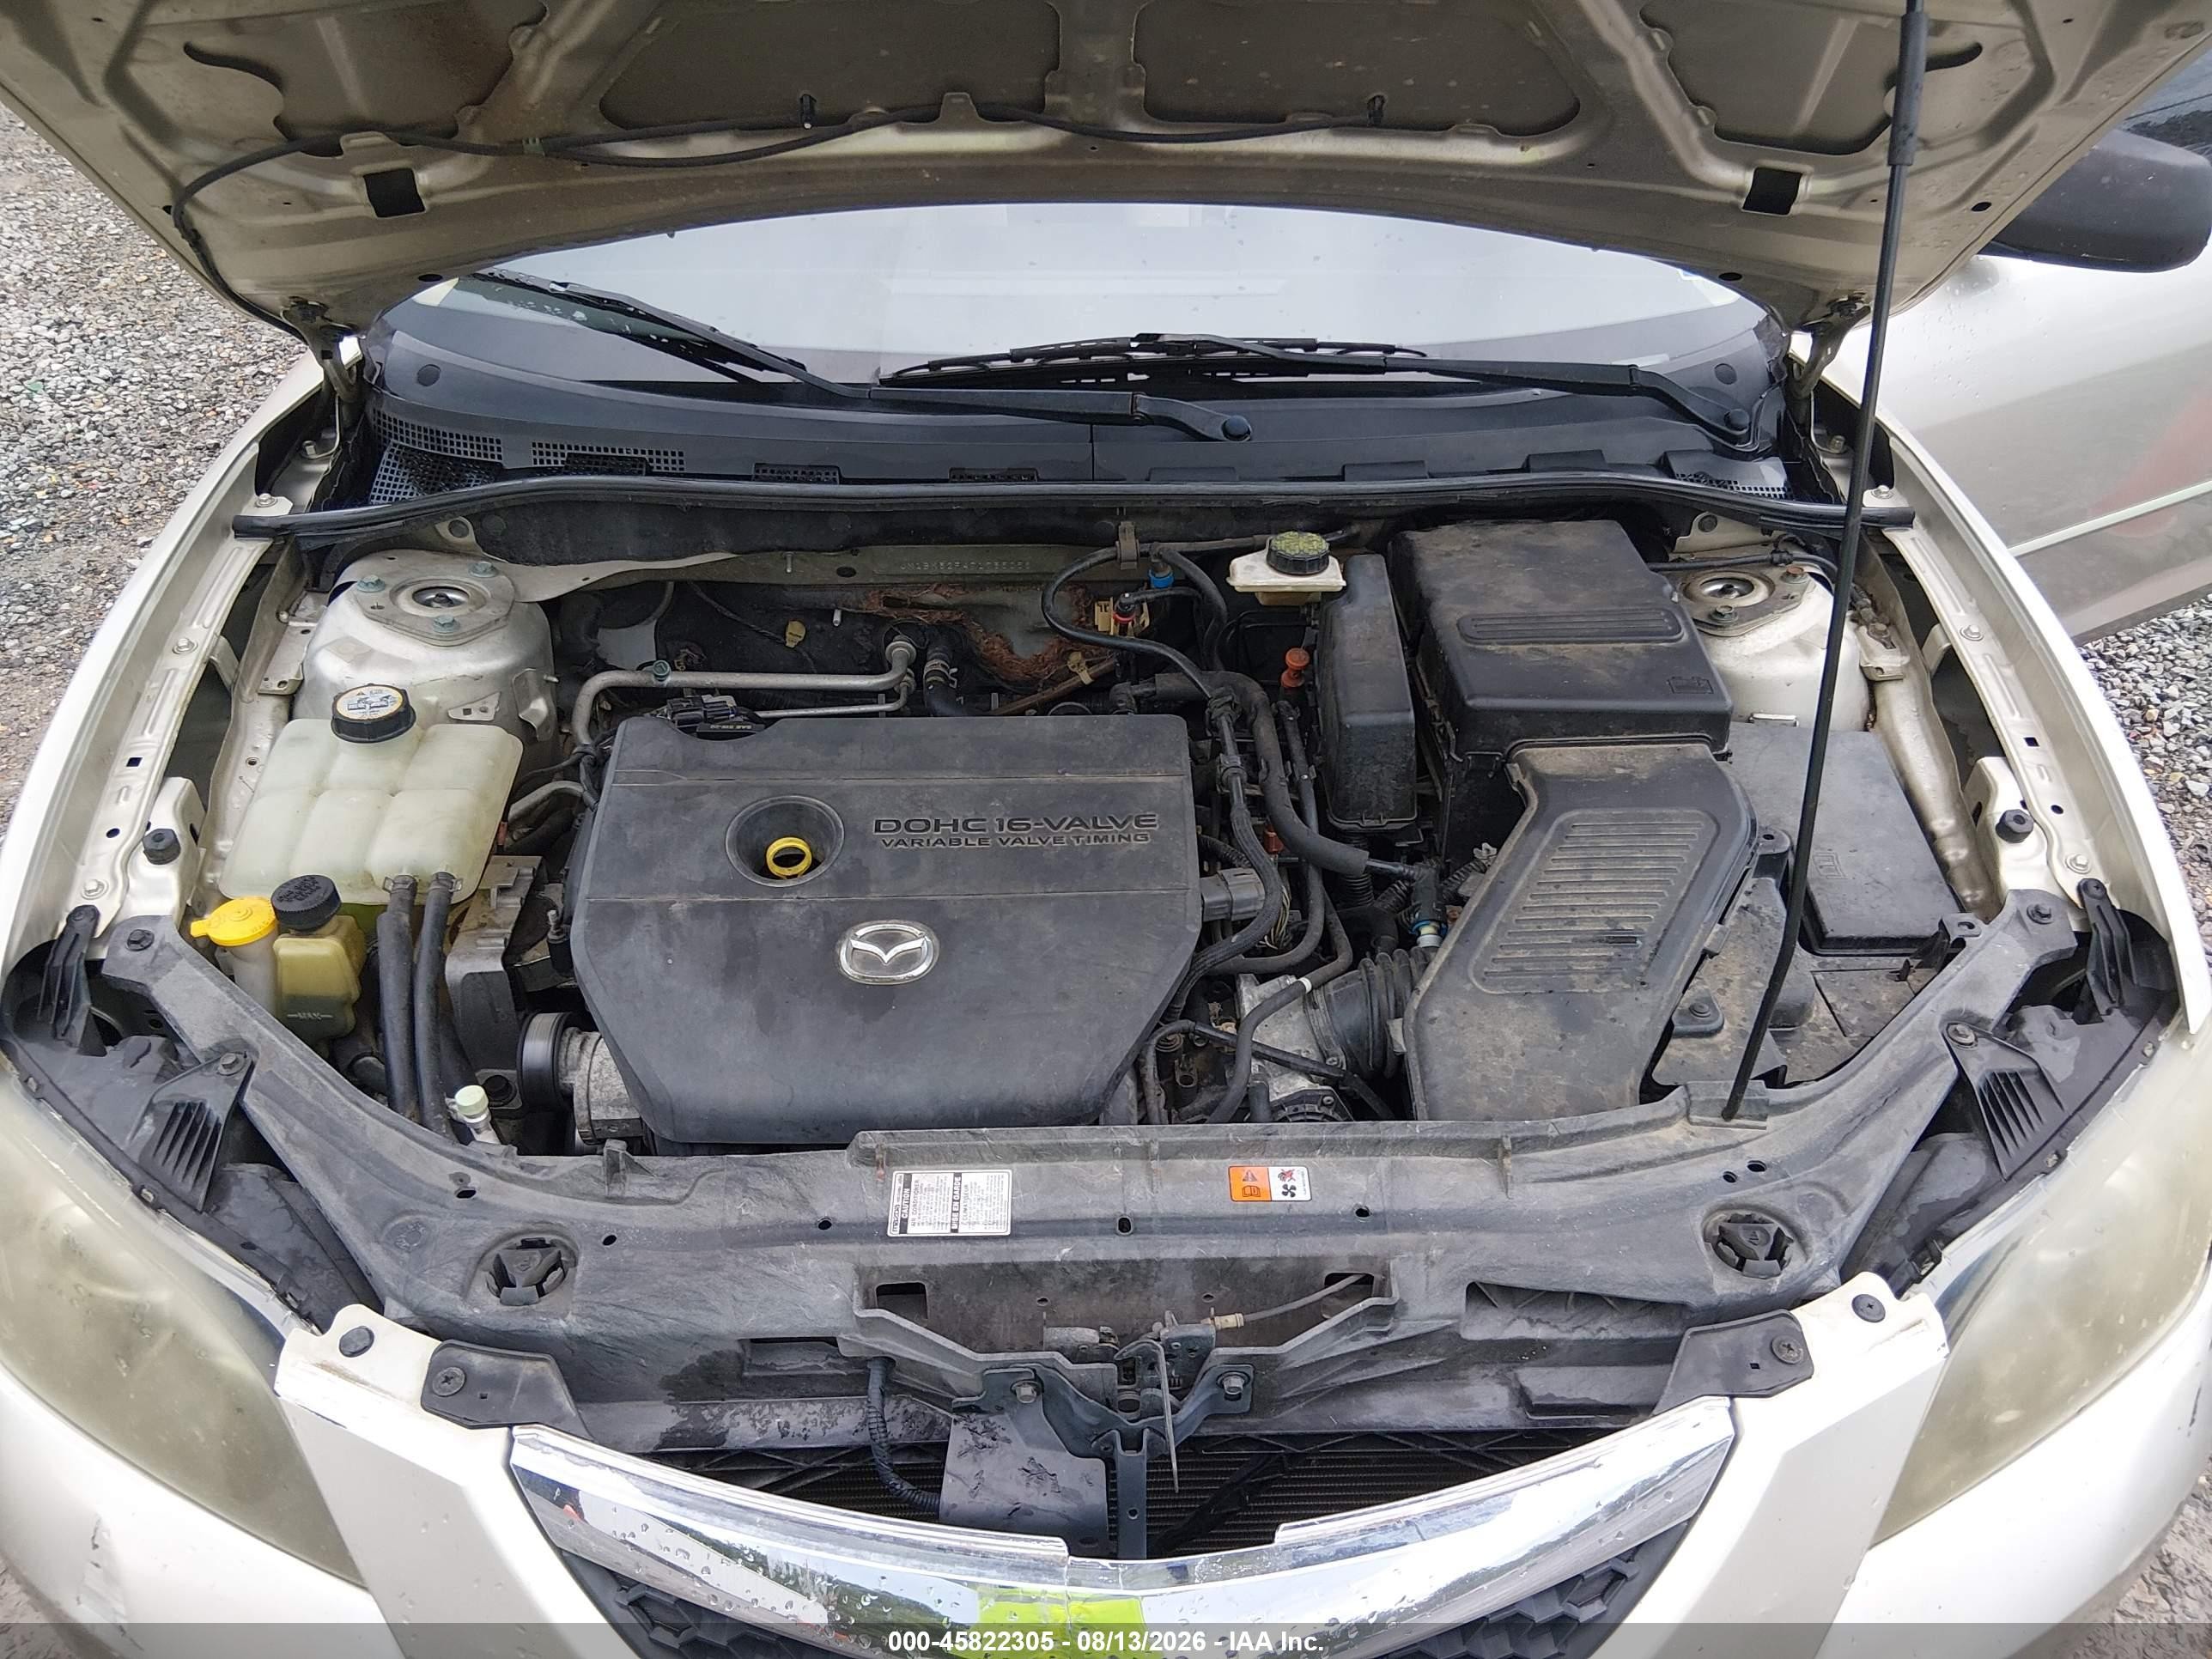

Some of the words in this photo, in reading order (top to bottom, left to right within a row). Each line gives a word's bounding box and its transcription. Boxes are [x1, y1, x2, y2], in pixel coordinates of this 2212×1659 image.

[873, 817, 988, 834] DOHC
[995, 814, 1158, 832] 16-VALVE
[881, 837, 991, 848] VARIABLE
[998, 835, 1066, 847] VALVE
[1073, 833, 1150, 845] TIMING
[901, 1188, 910, 1218] CAUTION
[952, 1201, 960, 1212] EN
[951, 1212, 959, 1230] MISE
